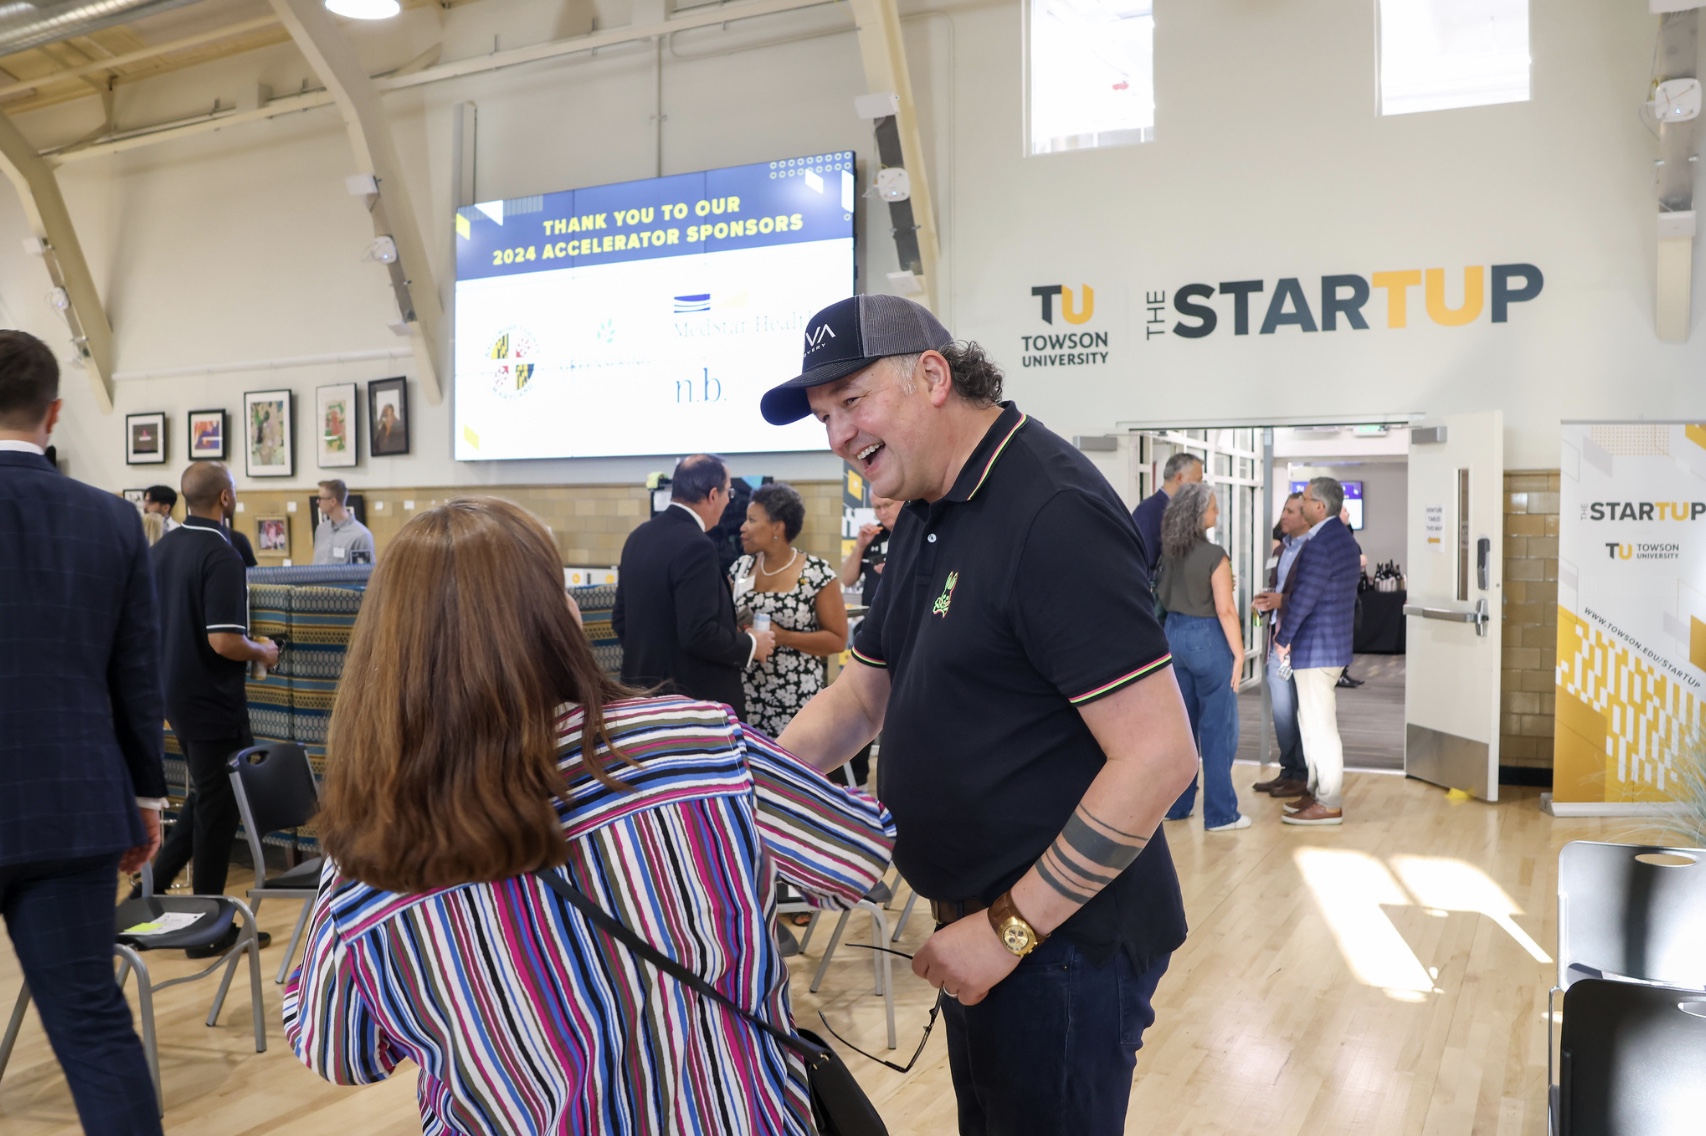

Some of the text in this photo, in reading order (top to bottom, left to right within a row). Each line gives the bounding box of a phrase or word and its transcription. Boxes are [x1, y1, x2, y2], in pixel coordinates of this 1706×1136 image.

[543, 196, 741, 236] THANK YOU TO OUR
[492, 213, 804, 266] 2024 ACCELERATOR SPONSORS
[1031, 283, 1095, 326] TU
[1147, 263, 1544, 341] THE STARTUP
[1021, 331, 1108, 352] TOWSON
[1022, 351, 1109, 368] UNIVERSITY
[1580, 501, 1706, 521] THE STARTUP
[1605, 542, 1633, 560] TU
[1636, 543, 1680, 552] TOWSON
[1636, 552, 1680, 560] UNIVERSITY
